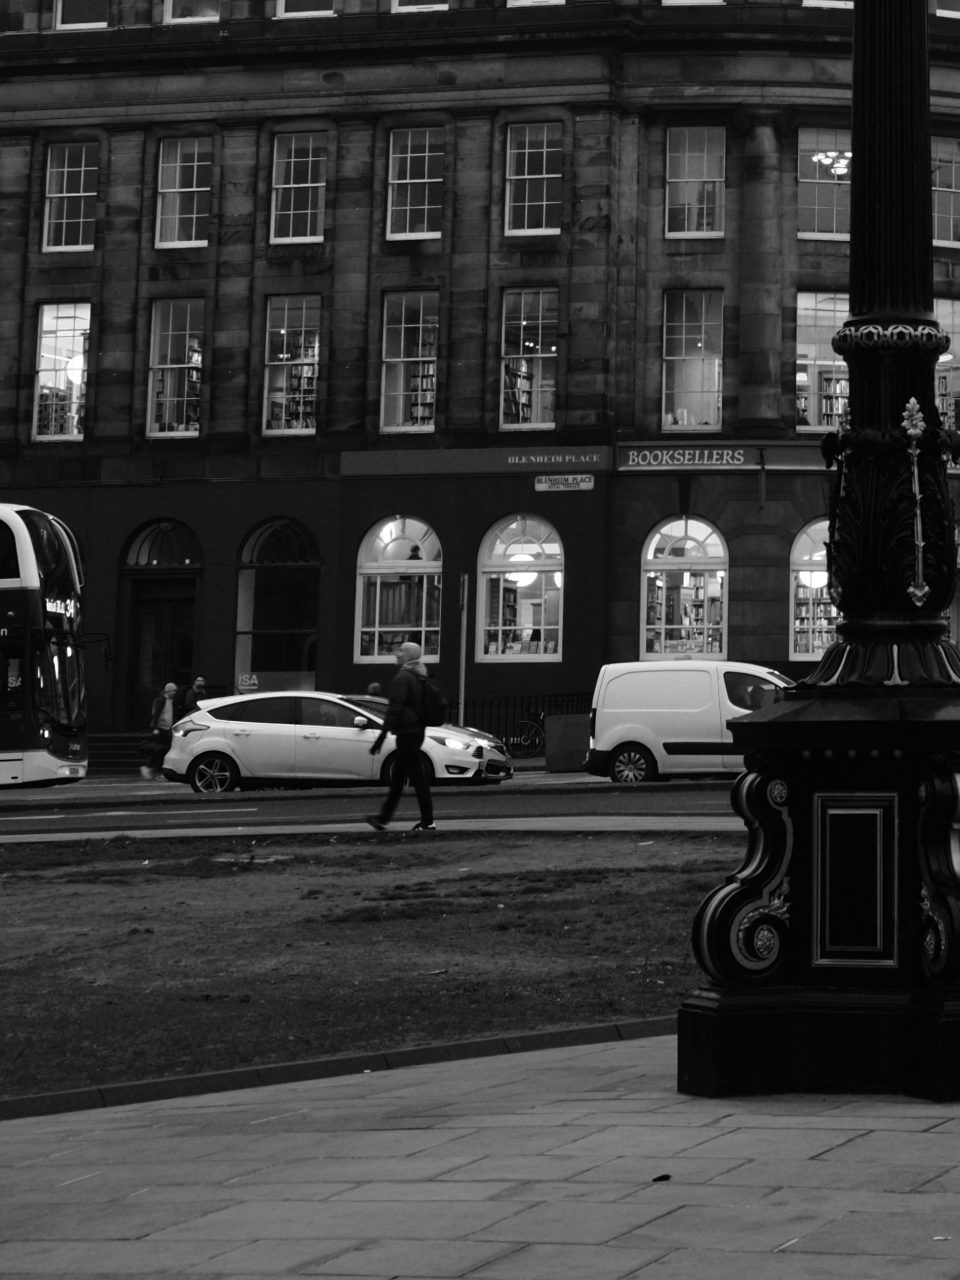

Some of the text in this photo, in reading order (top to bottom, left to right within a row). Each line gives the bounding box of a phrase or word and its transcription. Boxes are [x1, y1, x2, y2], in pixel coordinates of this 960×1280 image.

[508, 453, 600, 464] BLENHEIM PLACE
[628, 449, 744, 466] BOOKSELLERS
[66, 599, 75, 618] 34
[238, 674, 259, 686] ISA
